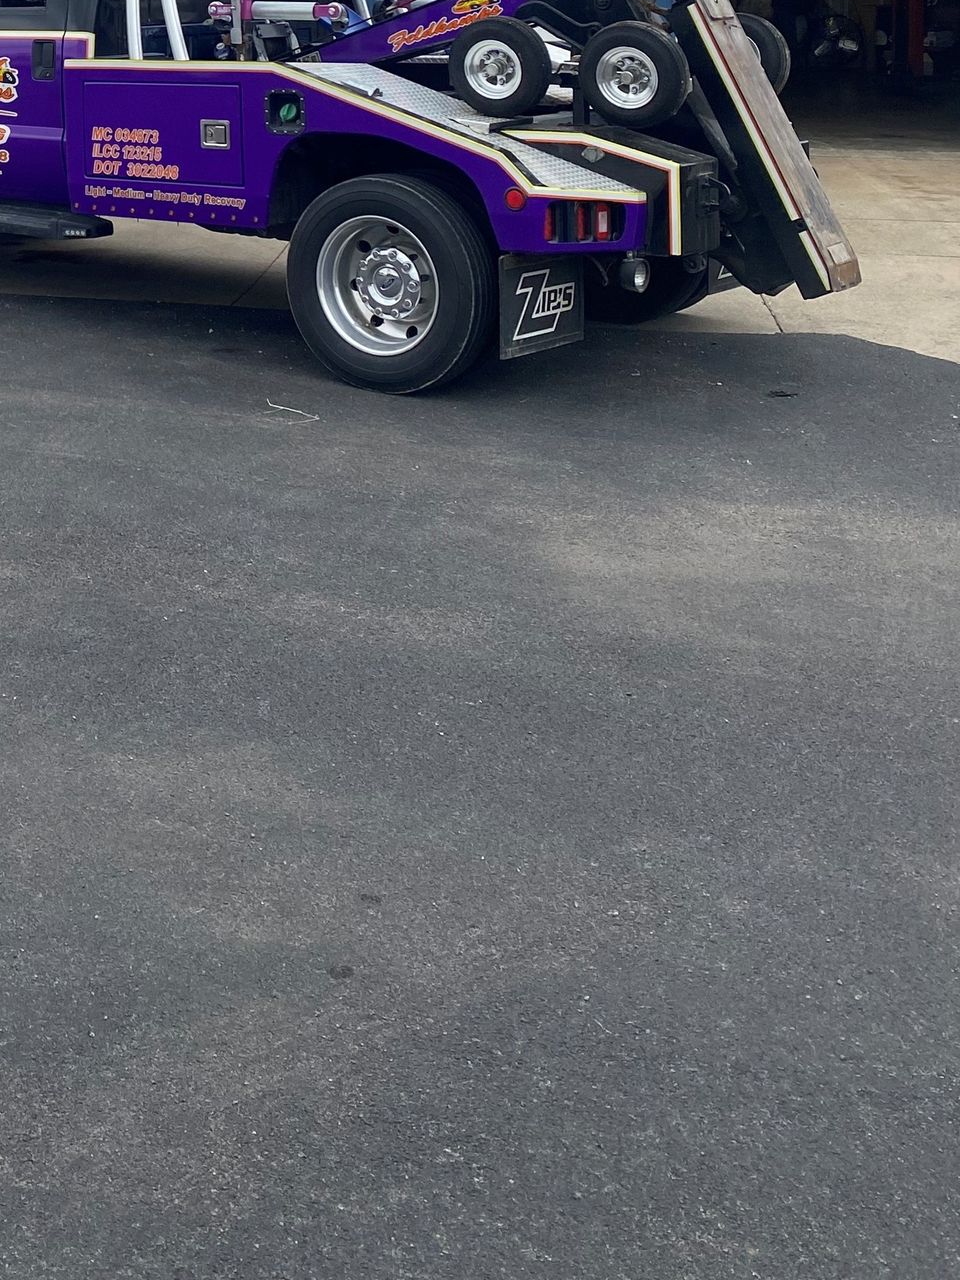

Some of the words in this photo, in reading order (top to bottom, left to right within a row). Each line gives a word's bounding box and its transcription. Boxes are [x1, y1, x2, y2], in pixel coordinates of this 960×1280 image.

[92, 126, 113, 141] MC
[114, 127, 159, 144] 034873
[92, 143, 120, 159] ILCC
[122, 145, 162, 162] 123215
[93, 159, 122, 175] DOT
[85, 185, 107, 198] Light
[113, 187, 145, 200] Medium
[153, 190, 180, 204] Heavy
[180, 192, 202, 206] Duty
[203, 194, 246, 210] Recovery
